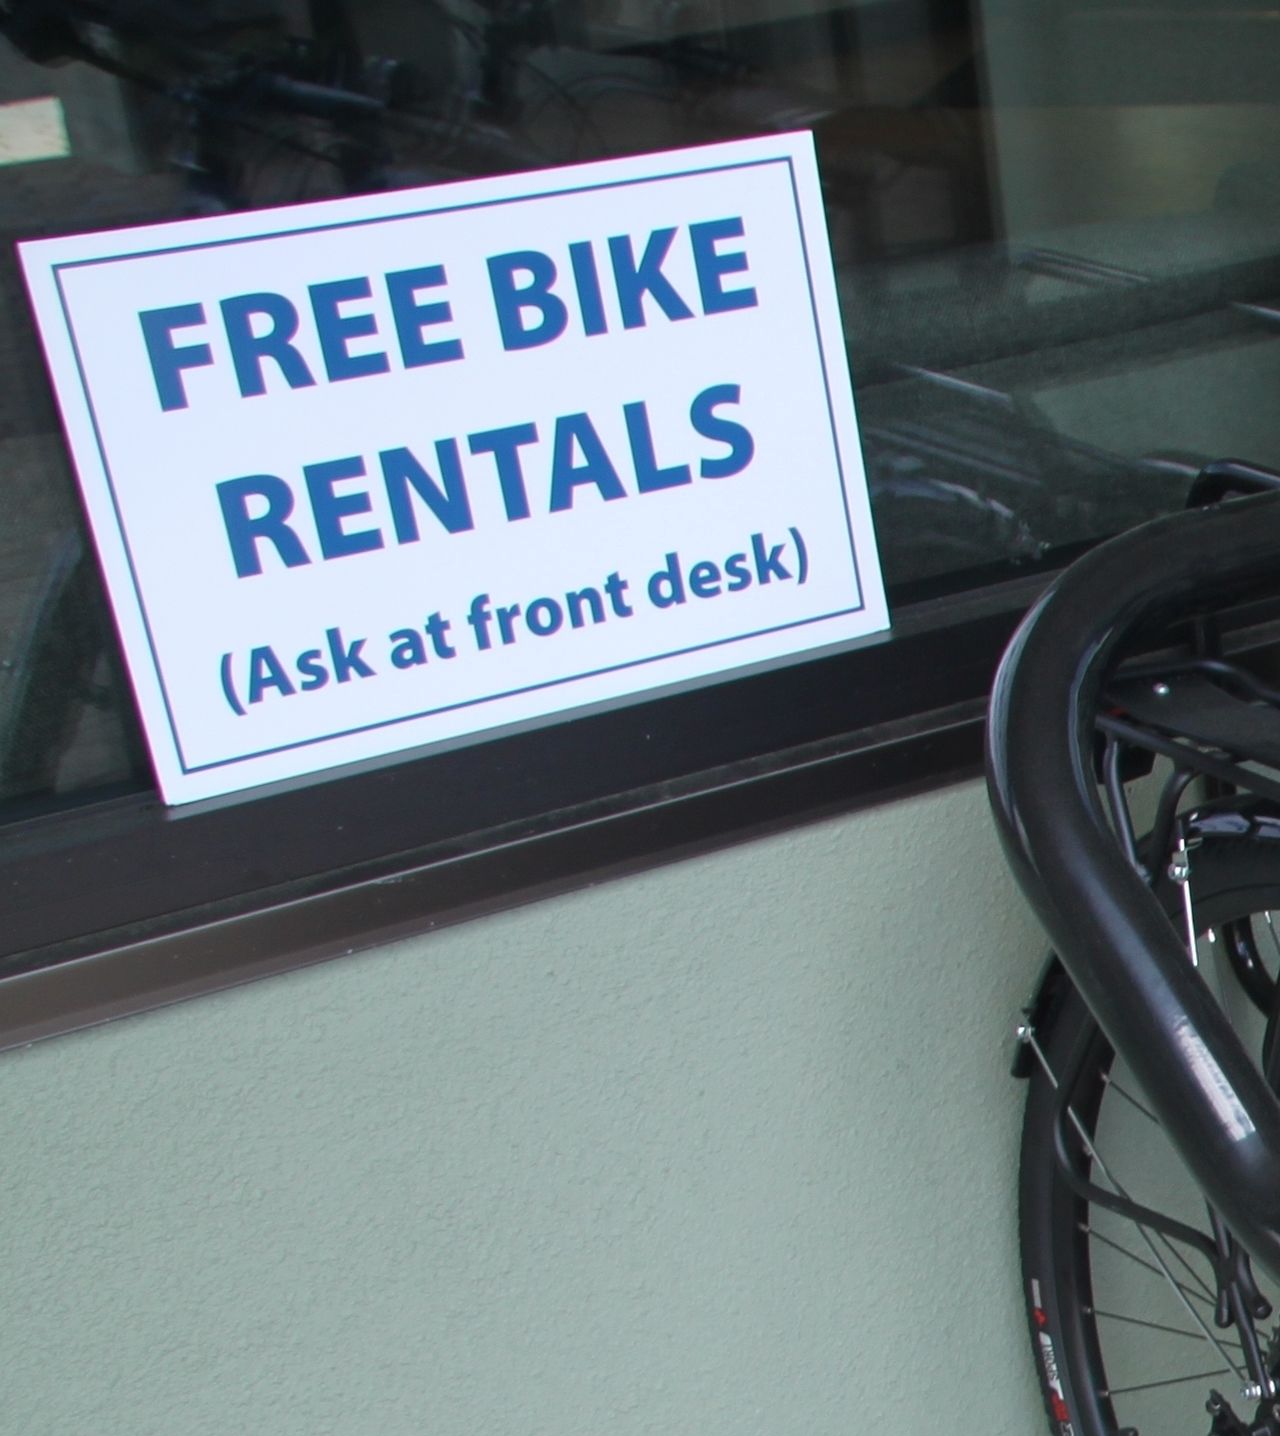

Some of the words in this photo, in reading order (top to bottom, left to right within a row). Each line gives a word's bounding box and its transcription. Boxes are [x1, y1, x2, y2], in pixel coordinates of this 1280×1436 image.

[138, 265, 466, 412] FREE
[485, 216, 759, 352] BIKE
[215, 383, 756, 578] RENTALS
[220, 627, 376, 716] (Ask
[389, 611, 456, 669] at
[465, 571, 634, 651] front
[647, 527, 809, 609] desk)
